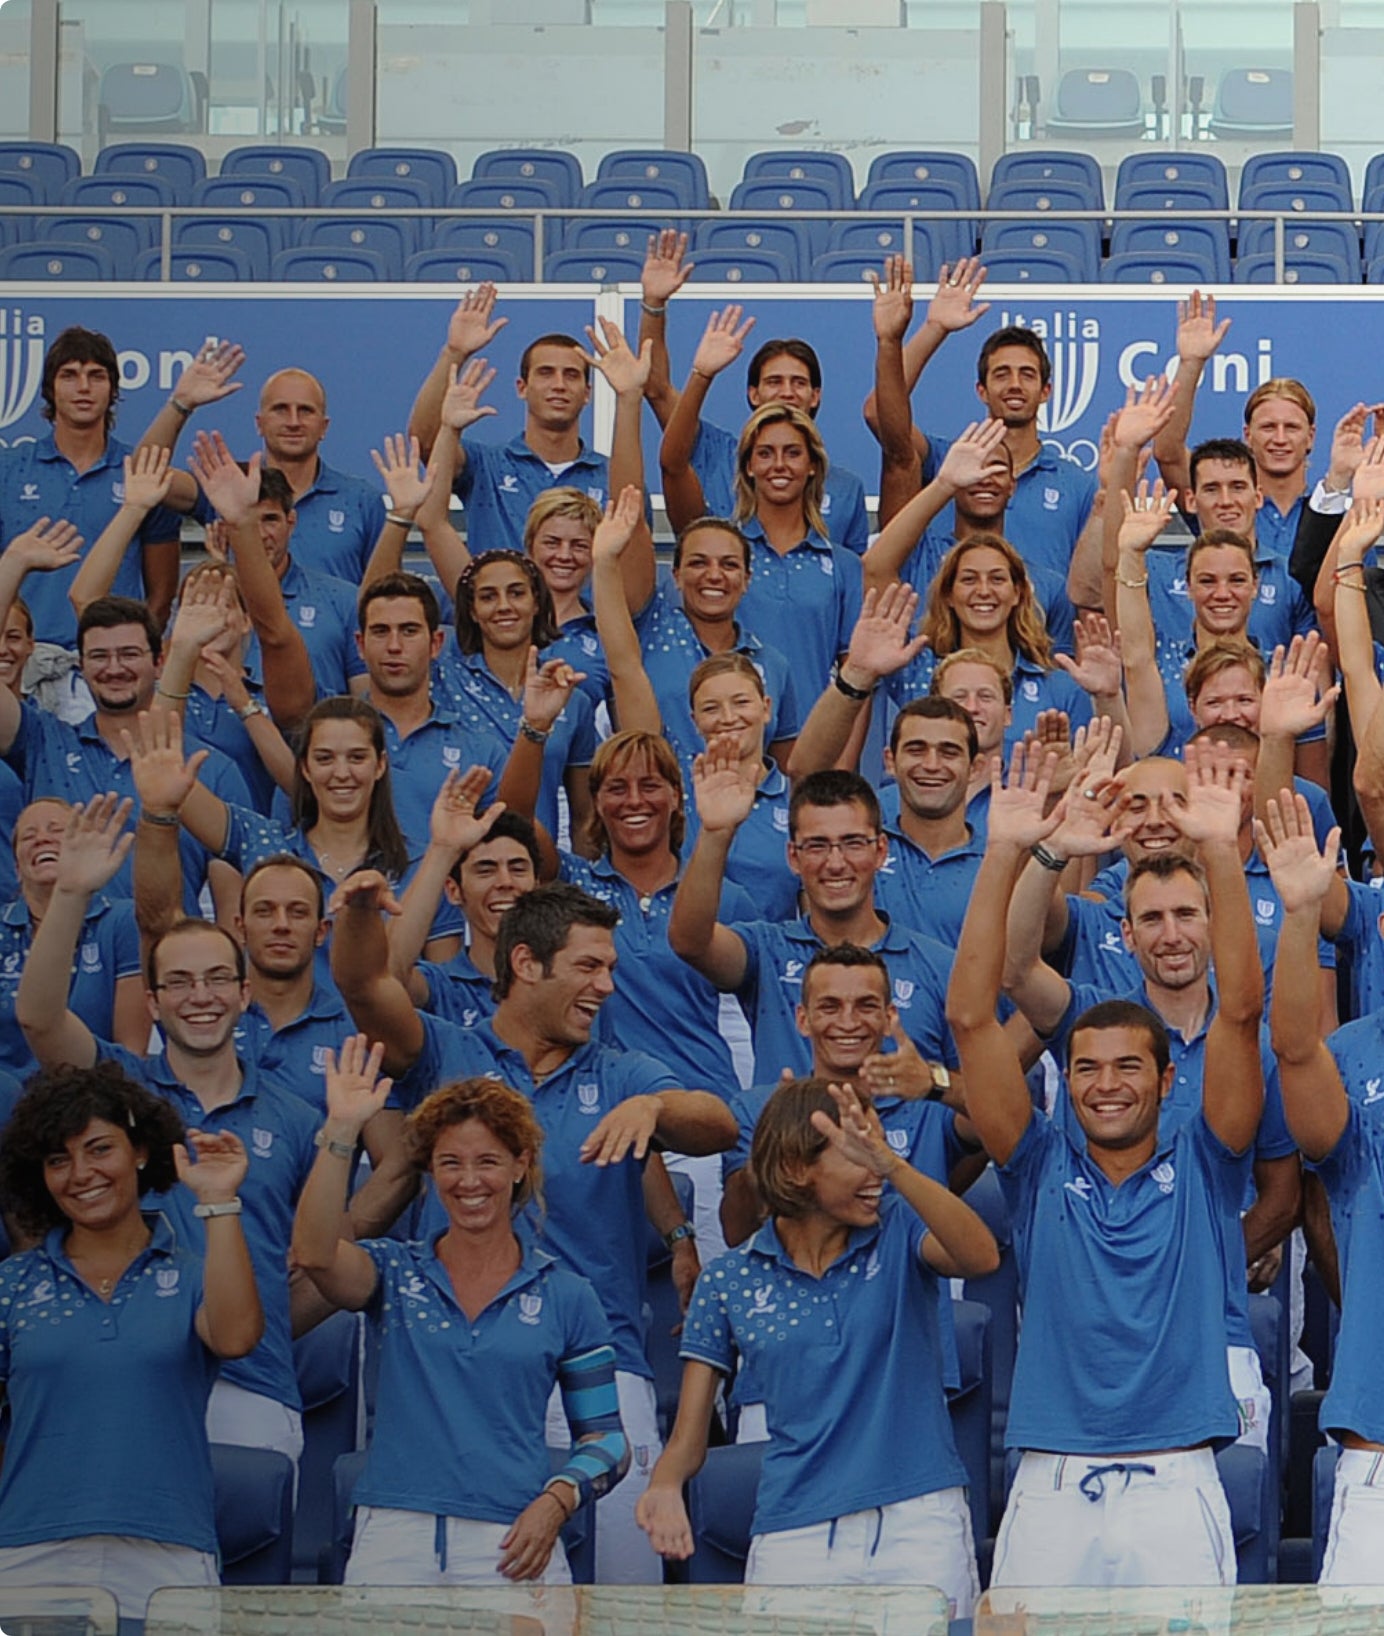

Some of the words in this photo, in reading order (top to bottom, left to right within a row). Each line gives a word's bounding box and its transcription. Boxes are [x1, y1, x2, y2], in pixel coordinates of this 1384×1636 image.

[0, 309, 45, 335] lia
[1002, 312, 1099, 338] Italia
[118, 337, 219, 390] on
